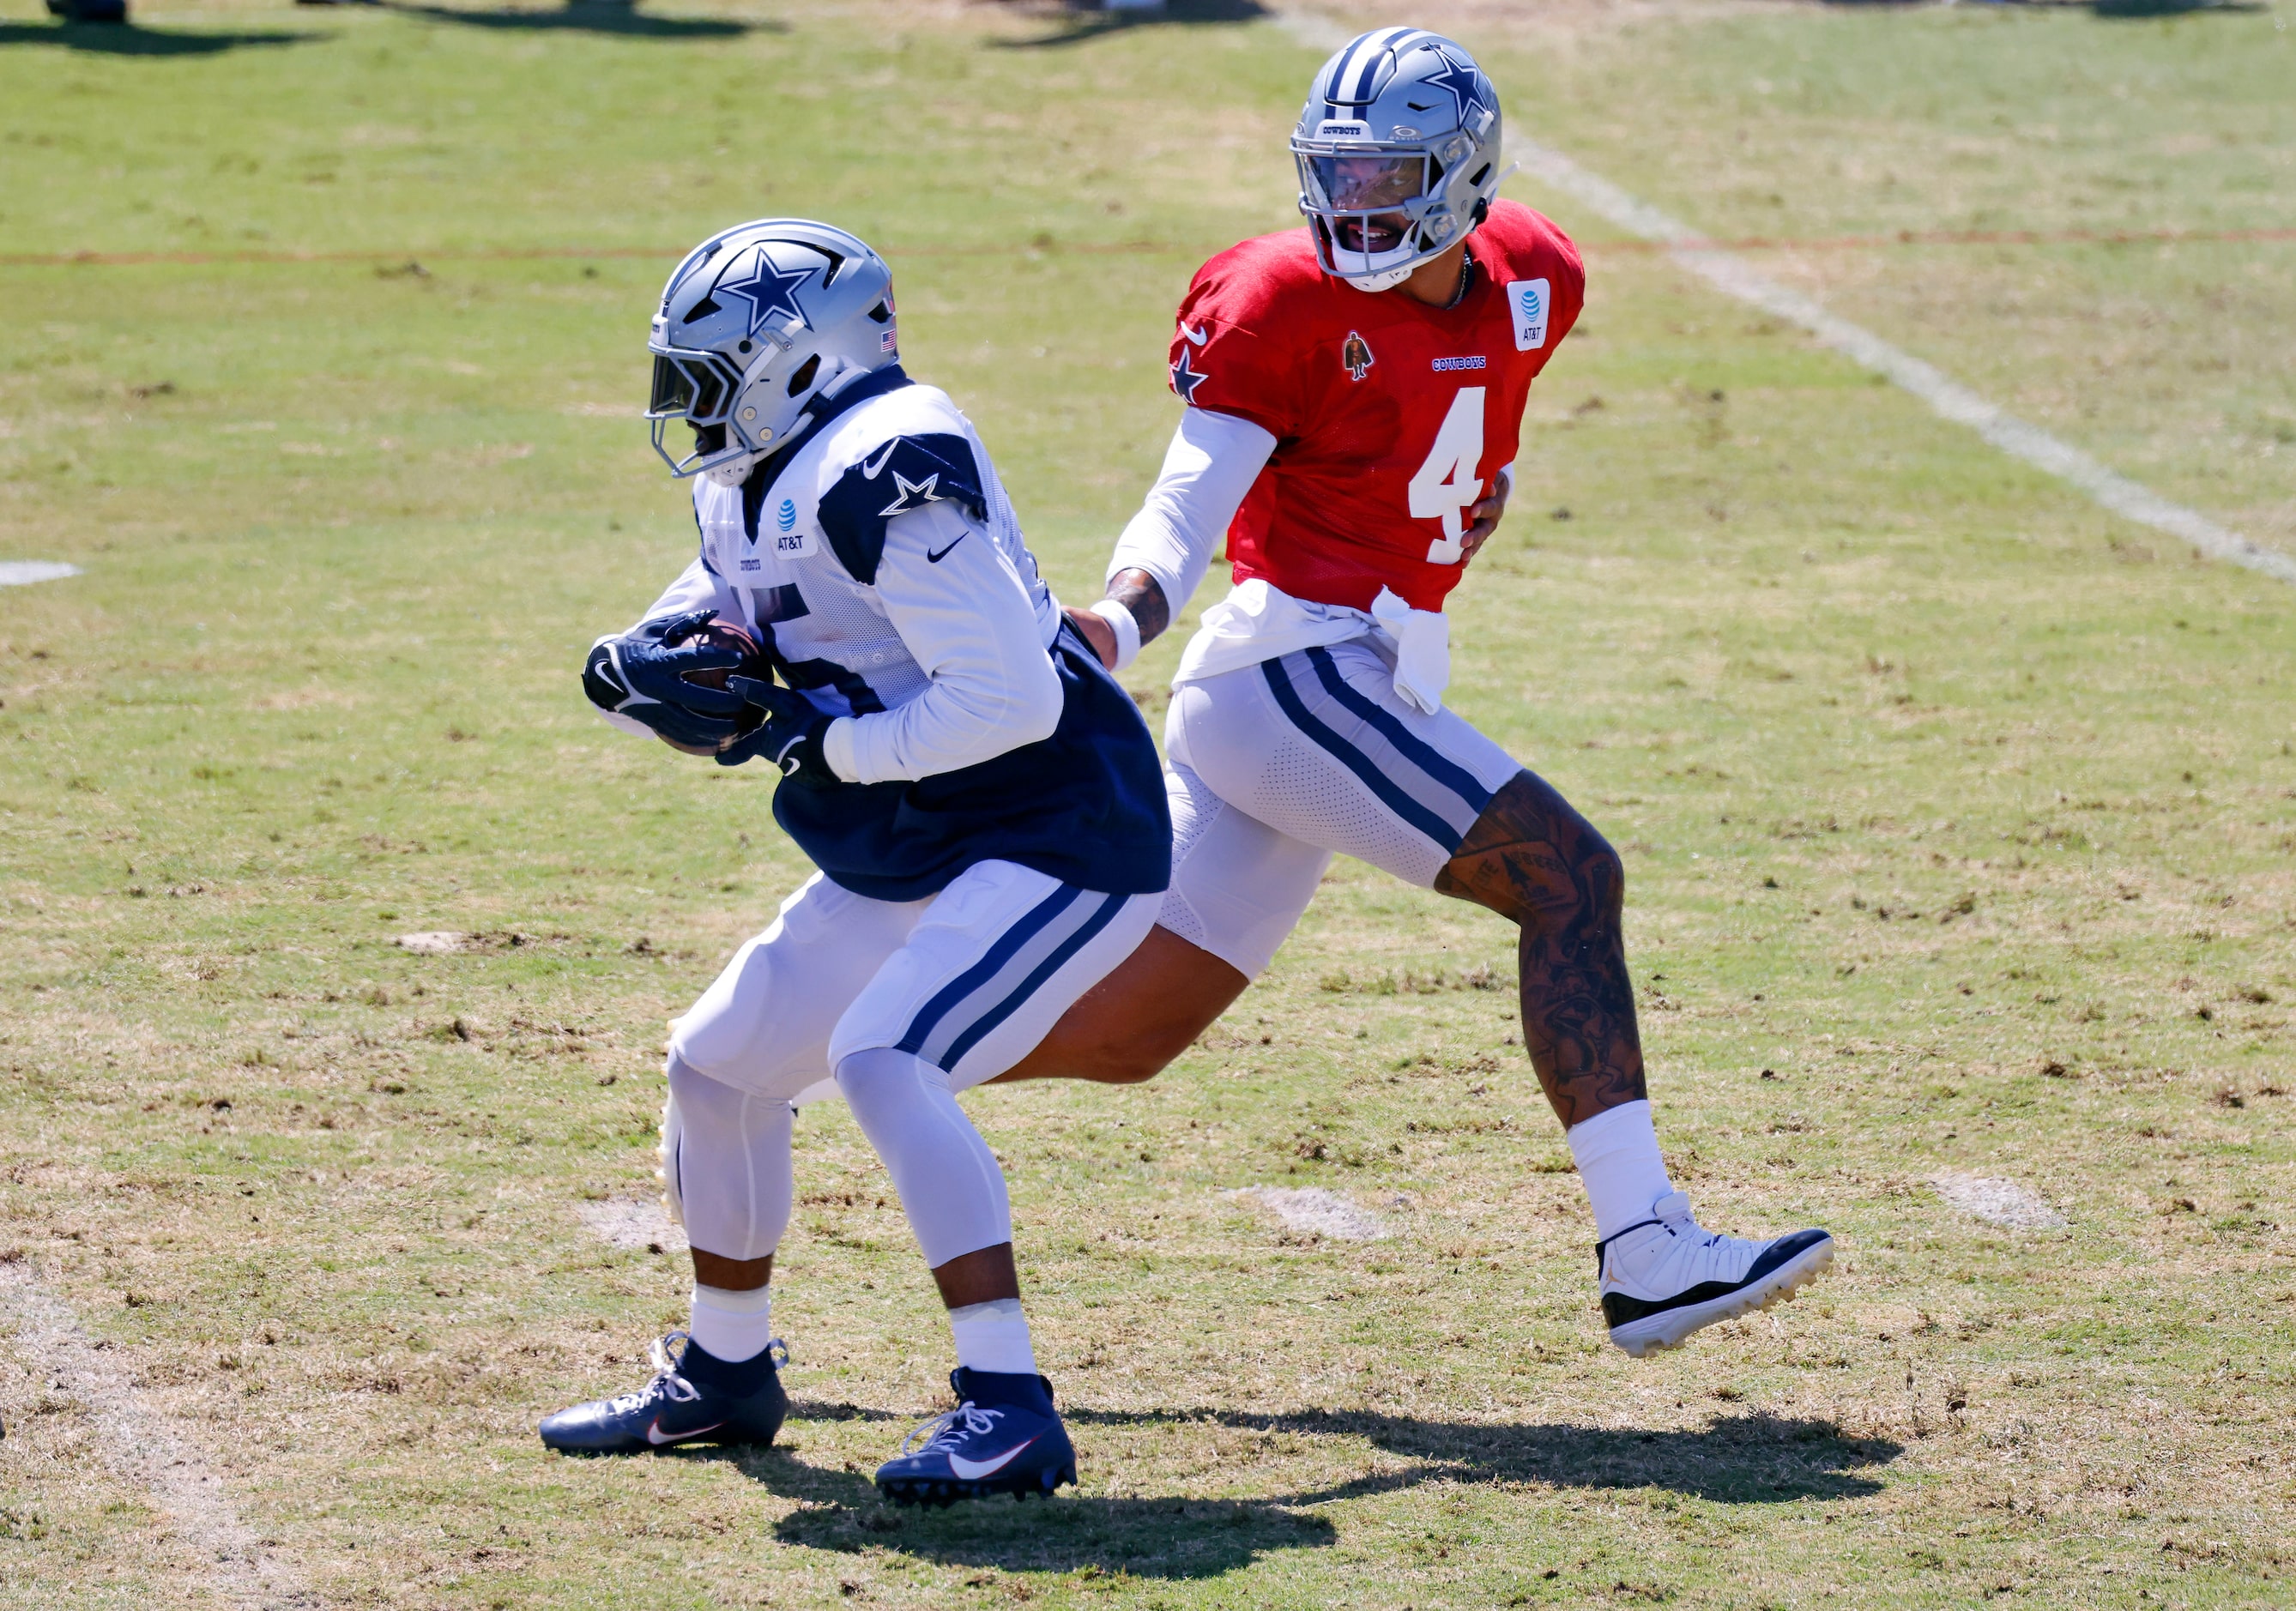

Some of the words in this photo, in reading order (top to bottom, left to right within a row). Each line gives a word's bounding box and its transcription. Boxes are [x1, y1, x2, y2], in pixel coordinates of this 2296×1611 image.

[1523, 327, 1542, 341] AT&T
[1432, 356, 1486, 371] COWBOYS
[1408, 386, 1485, 564] 4
[777, 535, 804, 552] AT&T
